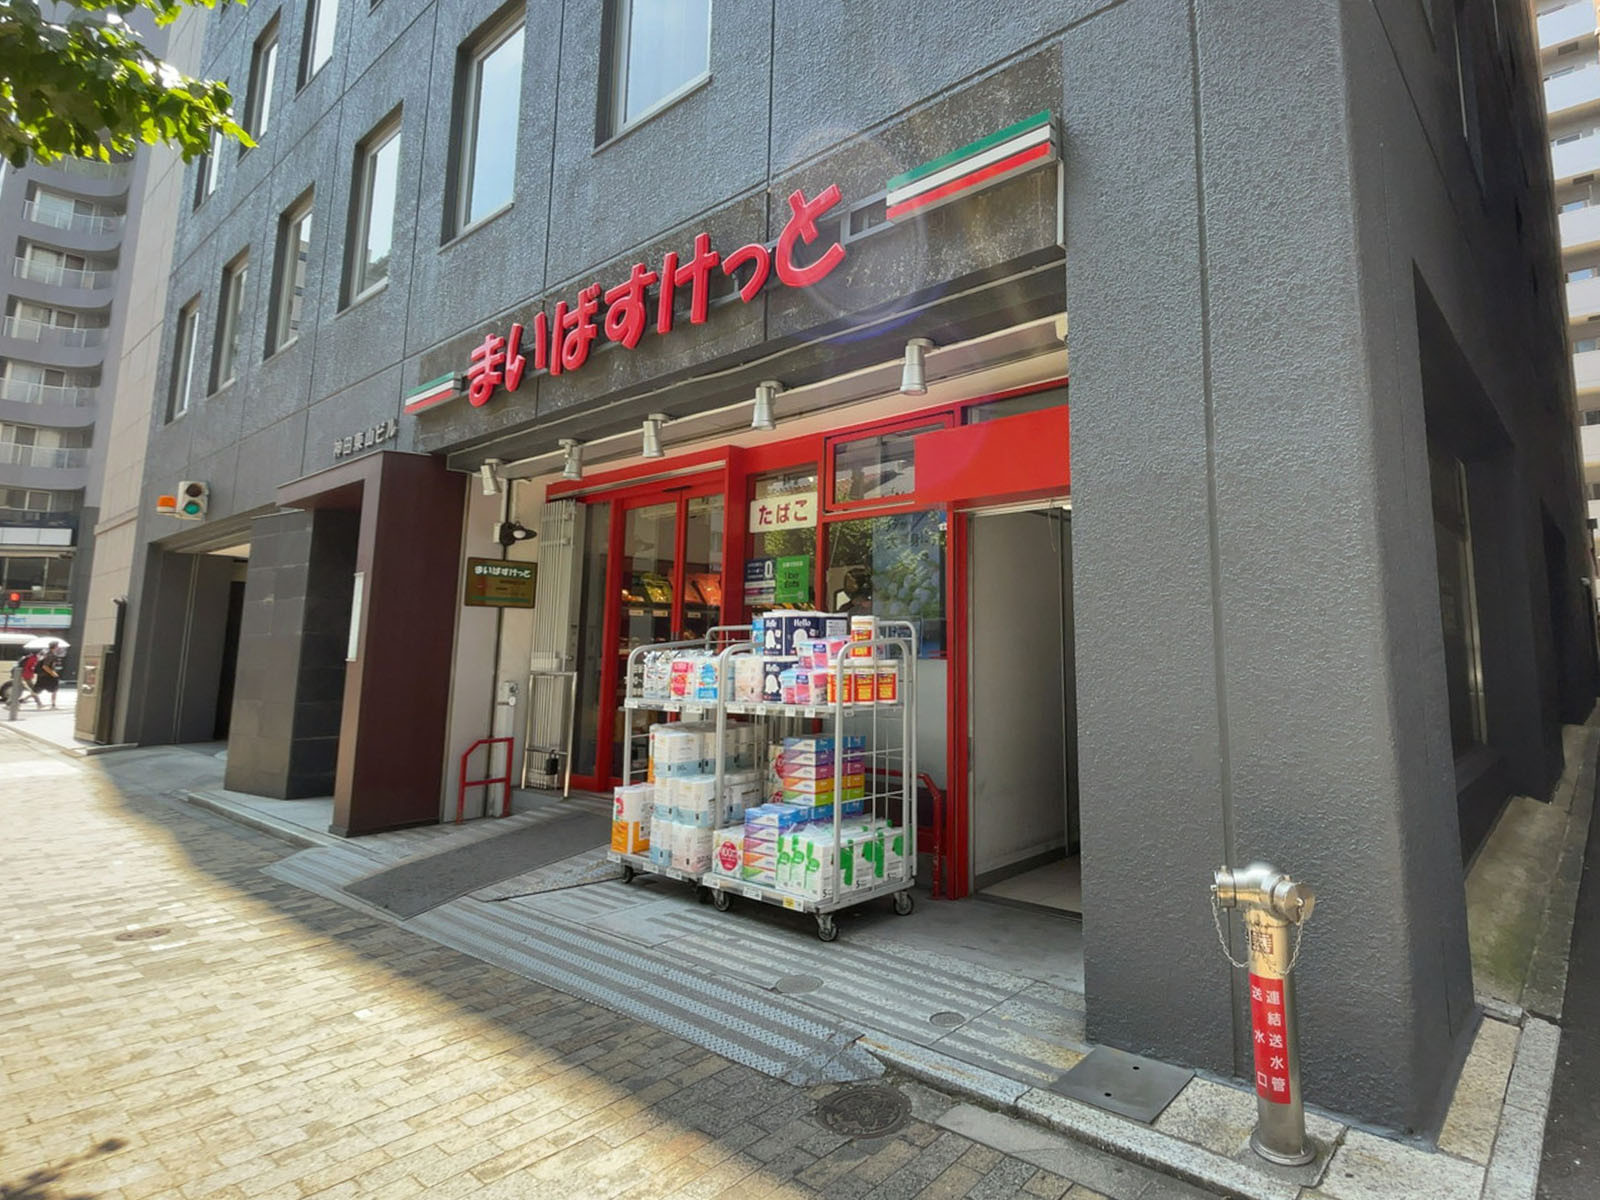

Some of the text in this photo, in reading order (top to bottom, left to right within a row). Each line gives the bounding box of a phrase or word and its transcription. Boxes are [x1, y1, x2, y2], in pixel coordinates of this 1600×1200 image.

[467, 183, 847, 408] まいばすけっと
[758, 499, 808, 526] たばこ
[793, 619, 812, 627] Hello
[1252, 984, 1268, 1088] 送水口
[1266, 988, 1286, 1093] 連結送水管
